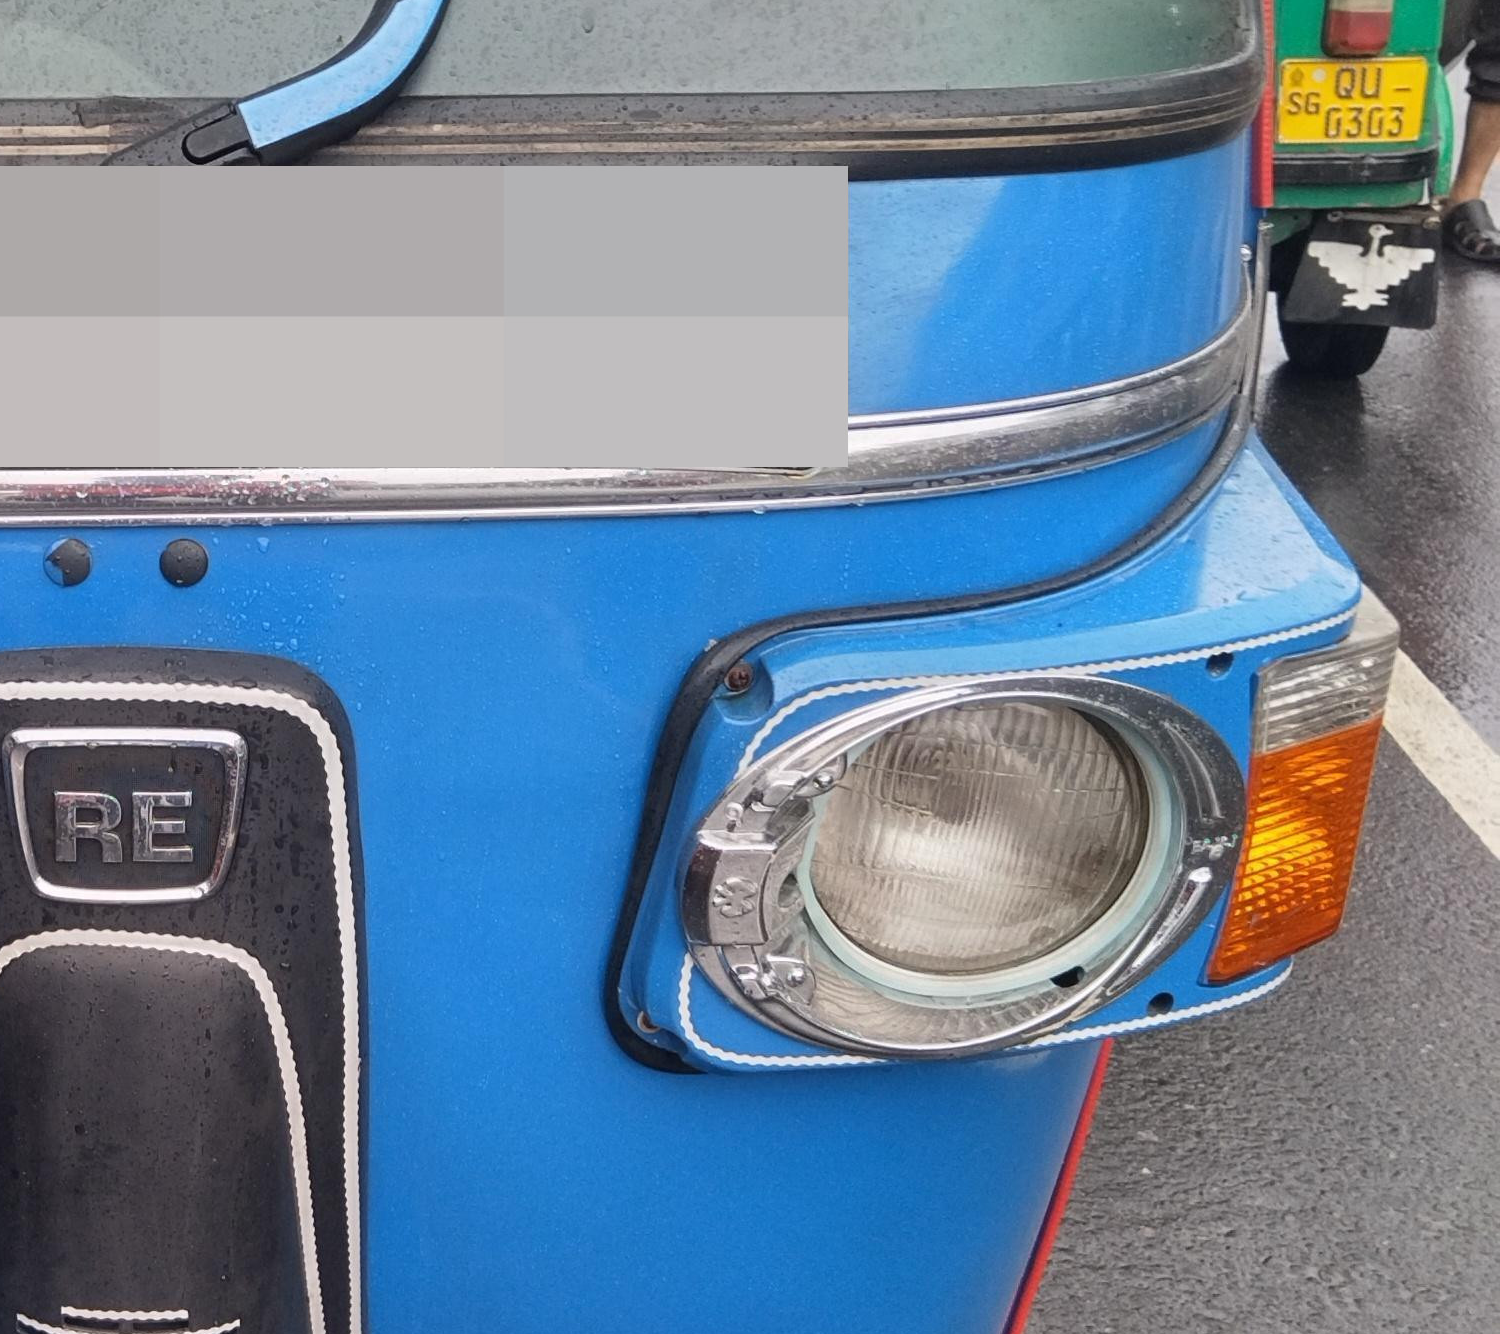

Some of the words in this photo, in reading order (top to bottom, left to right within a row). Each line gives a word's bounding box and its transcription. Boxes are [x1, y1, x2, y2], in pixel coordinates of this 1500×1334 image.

[1287, 91, 1321, 115] SG
[1325, 106, 1405, 138] 0303
[54, 790, 193, 863] RE
